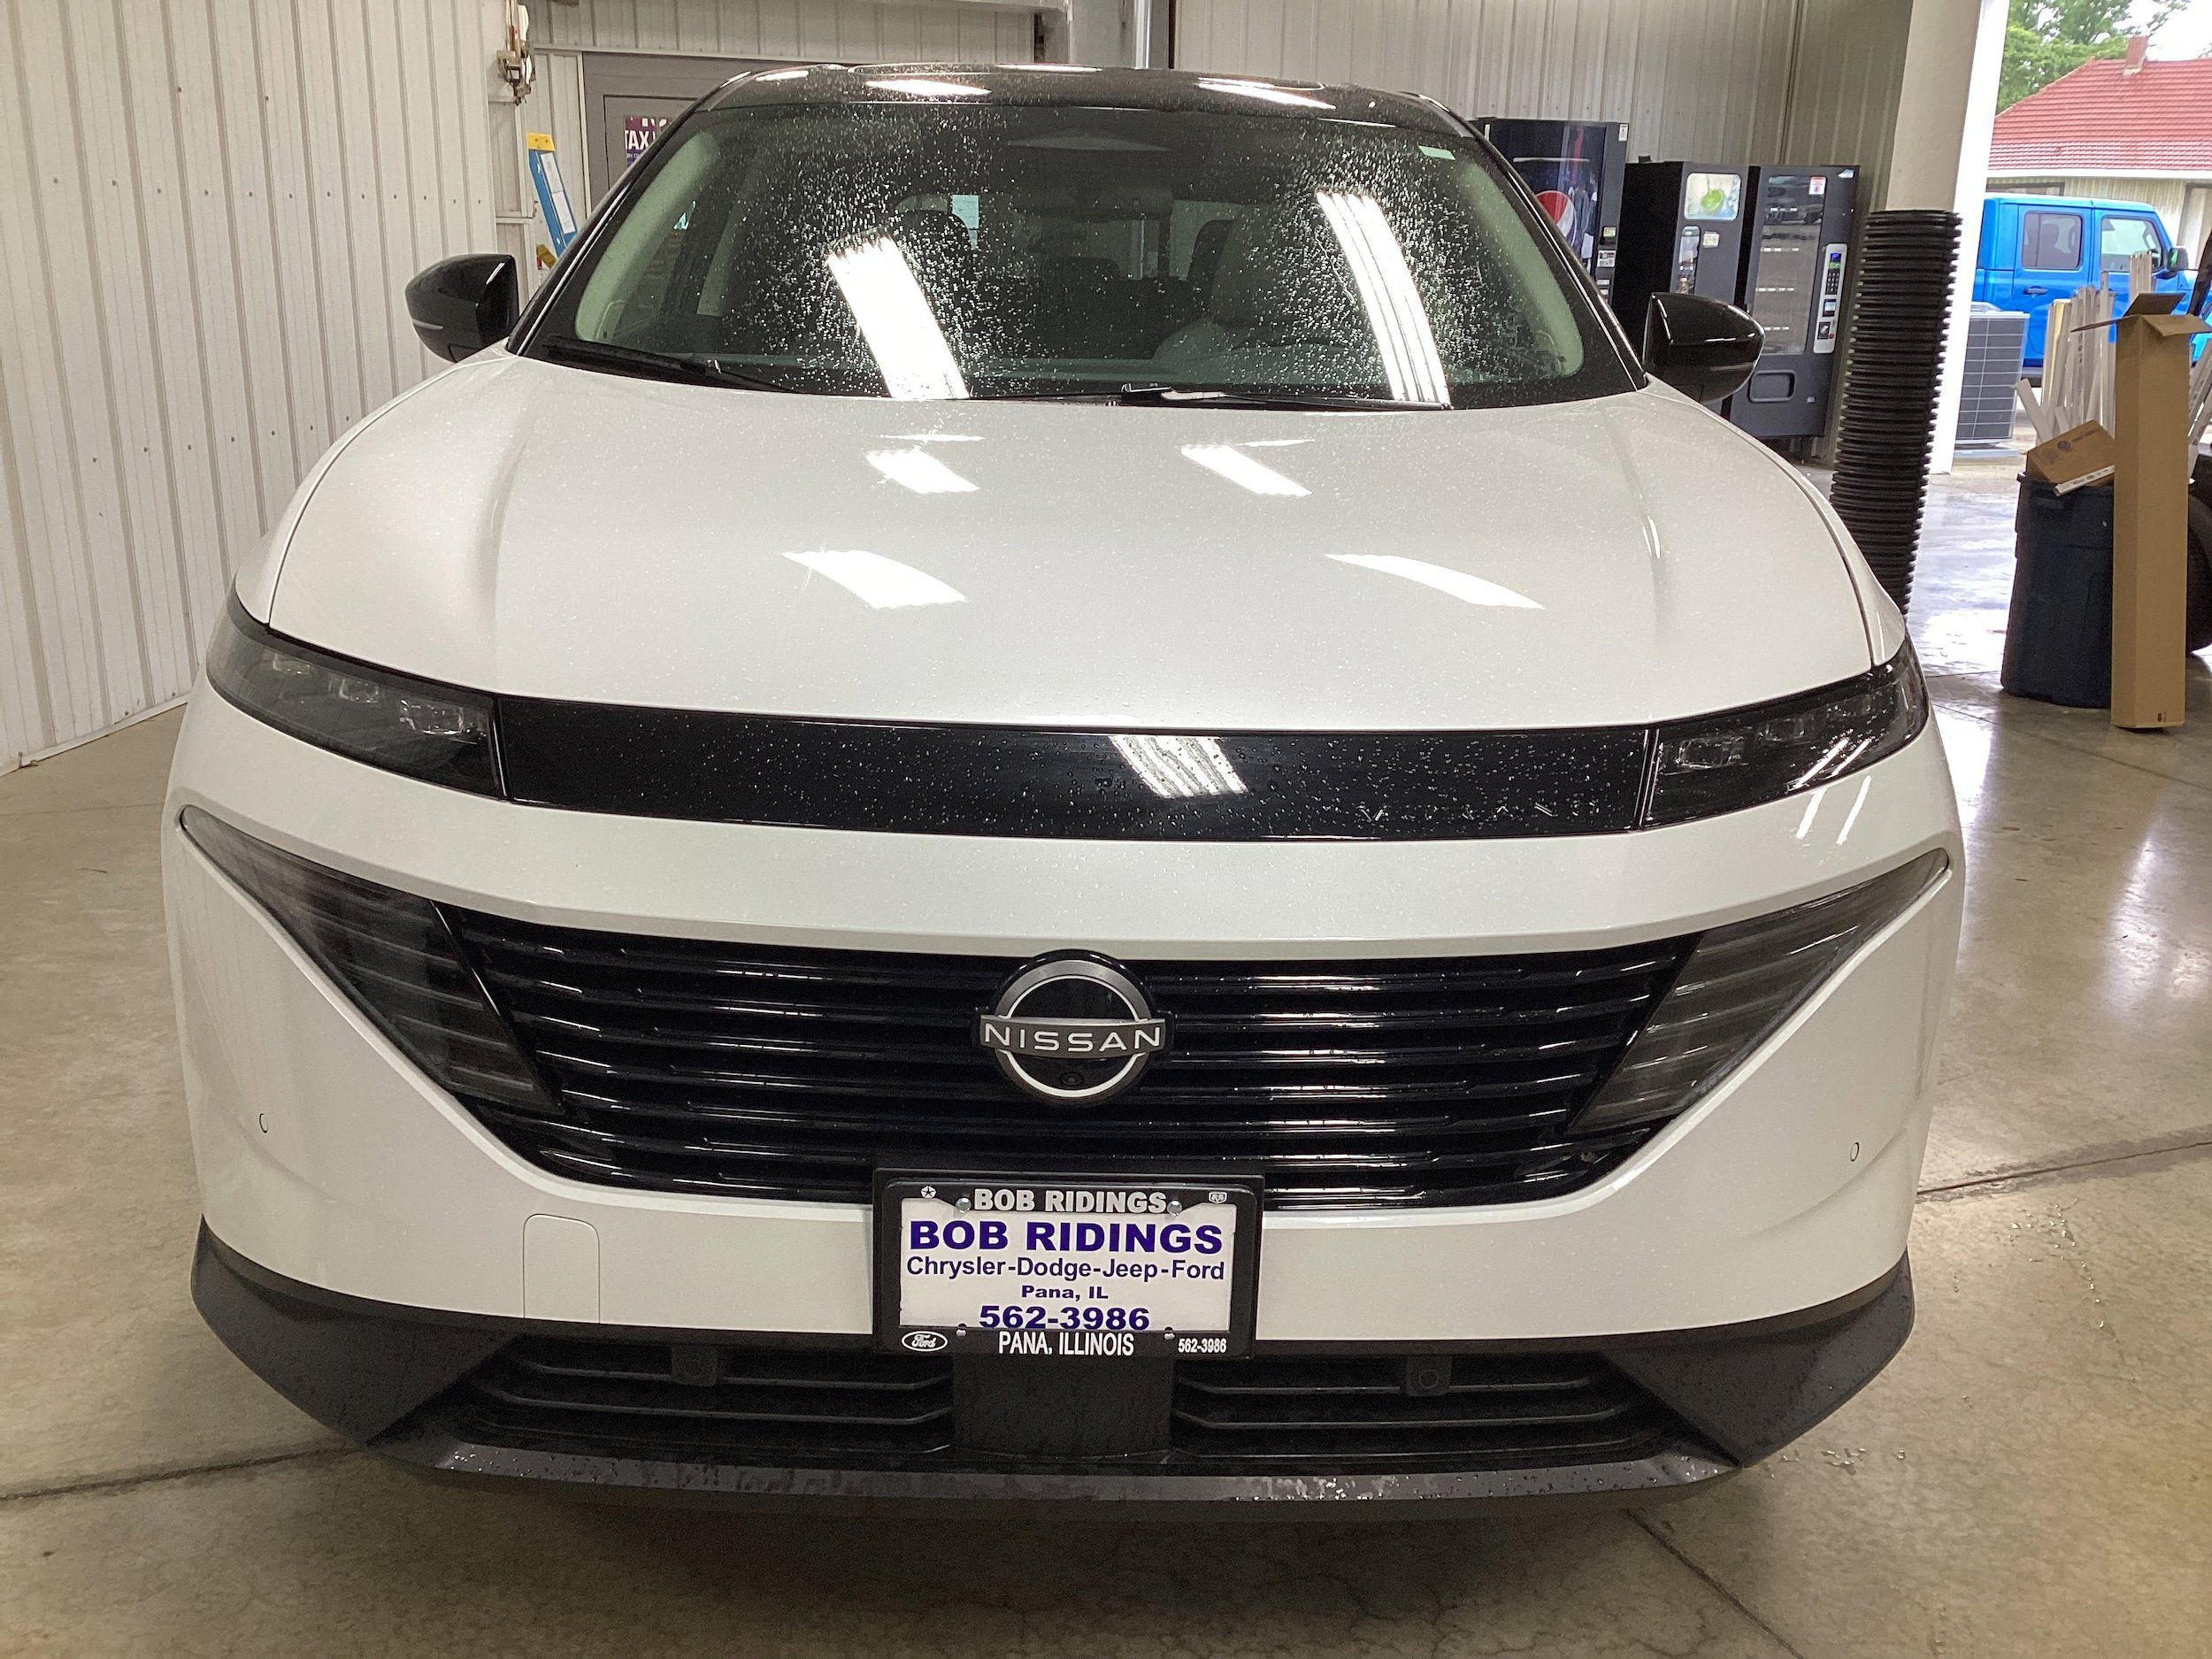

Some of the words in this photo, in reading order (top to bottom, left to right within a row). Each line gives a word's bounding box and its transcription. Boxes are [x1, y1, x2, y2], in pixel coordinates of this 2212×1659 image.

[985, 1023, 1161, 1052] NISSAN
[974, 1188, 1035, 1211] BOB
[1045, 1190, 1167, 1214] RIDINGS
[910, 1220, 1009, 1250] BOB
[1026, 1222, 1223, 1255] RIDINGS
[907, 1256, 1225, 1282] Chrysler-Dodge-Jeep-Ford
[1021, 1285, 1080, 1302] Pana,
[1088, 1286, 1109, 1299] IL
[979, 1305, 1150, 1331] 562-3986
[910, 1333, 937, 1348] Ford
[998, 1331, 1053, 1356] PANA,
[1058, 1333, 1135, 1356] ILLINOIS
[1178, 1338, 1228, 1354] 562-3986
